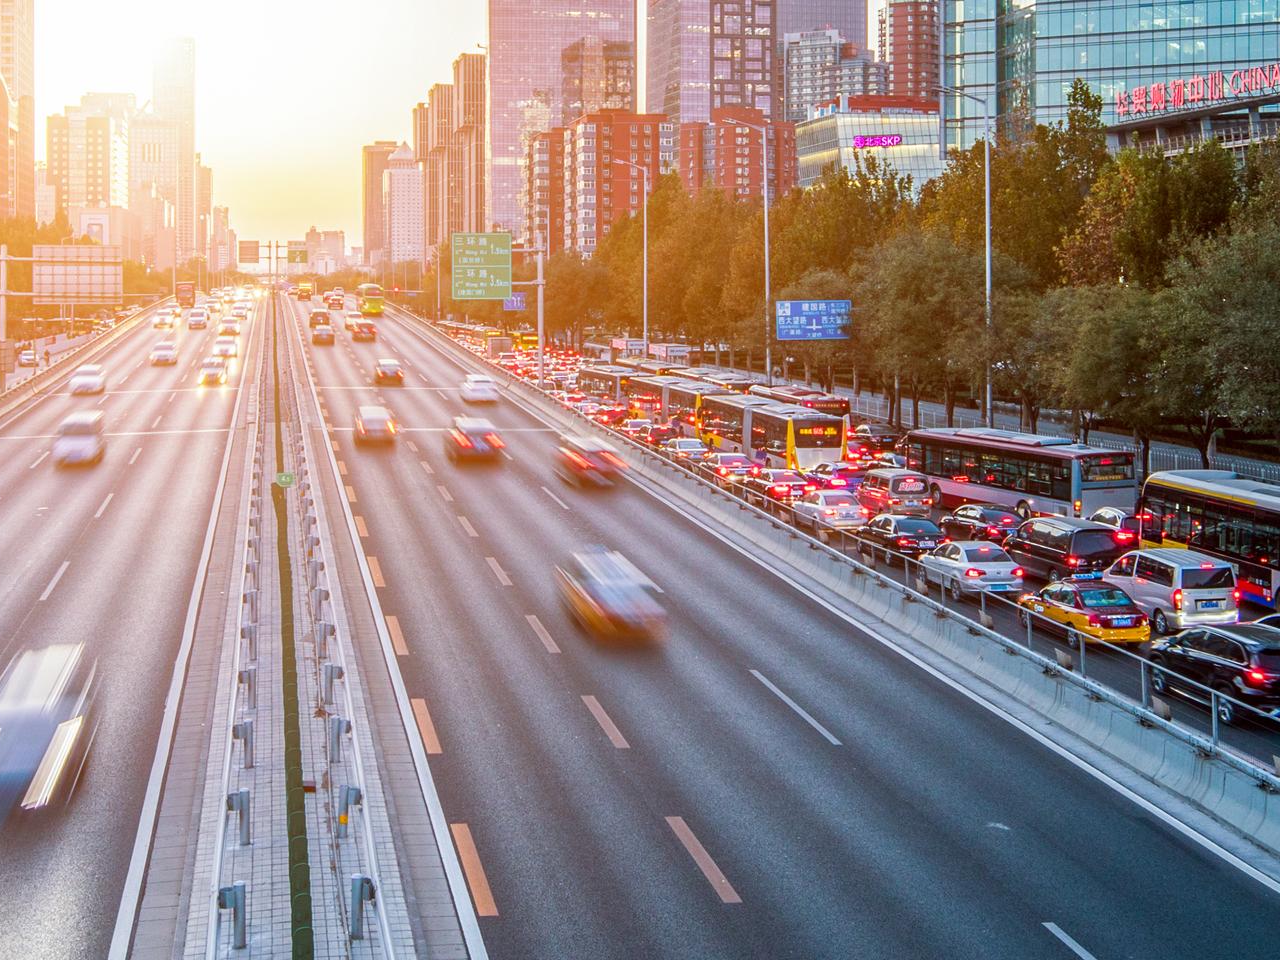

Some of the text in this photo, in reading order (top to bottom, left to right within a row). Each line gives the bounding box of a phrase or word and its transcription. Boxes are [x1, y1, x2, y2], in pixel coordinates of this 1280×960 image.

[1117, 70, 1224, 116] 华贸购物中心
